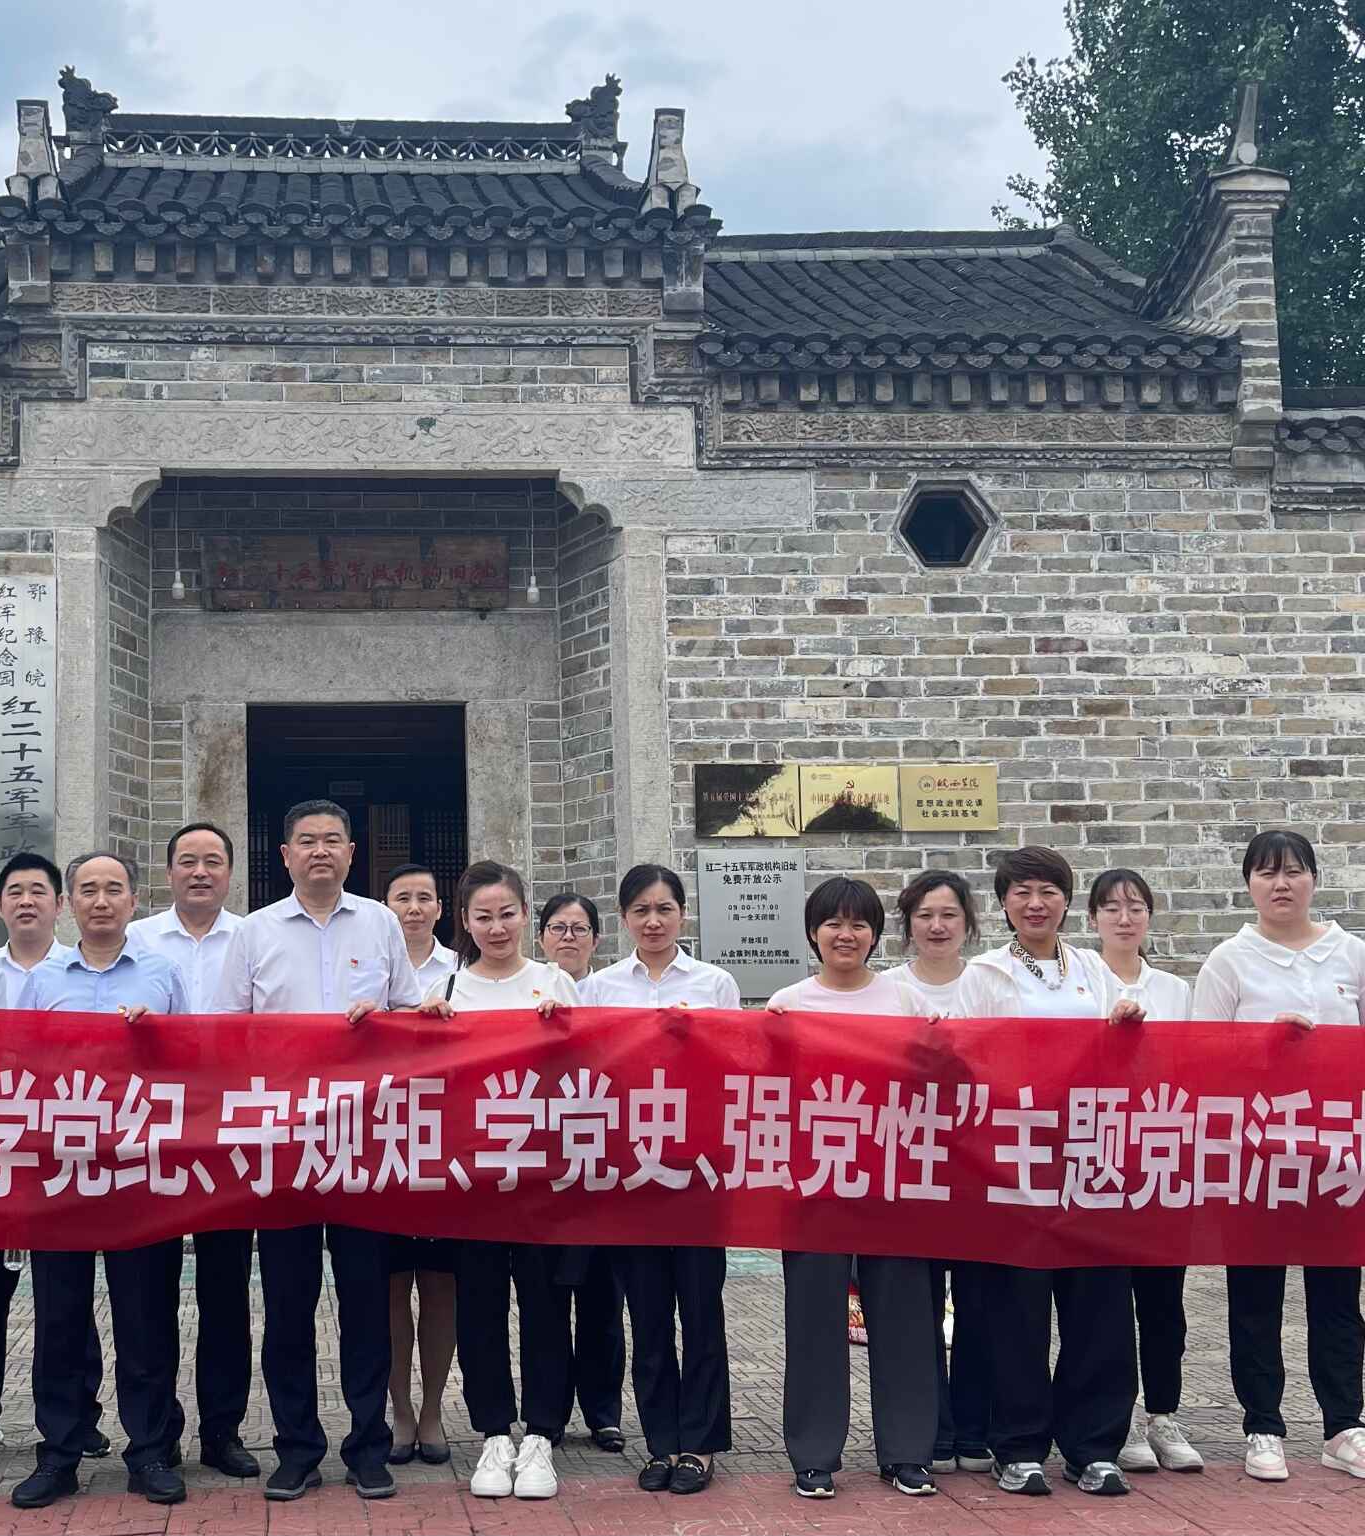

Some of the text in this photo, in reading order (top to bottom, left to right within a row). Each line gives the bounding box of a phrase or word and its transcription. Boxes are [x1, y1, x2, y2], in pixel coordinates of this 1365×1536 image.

[24, 583, 48, 688] 鄂豫皖
[922, 809, 980, 818] 社会实践基地
[705, 861, 798, 873] 红二十五军军政机构旧址
[723, 873, 782, 885] 免费开放公示
